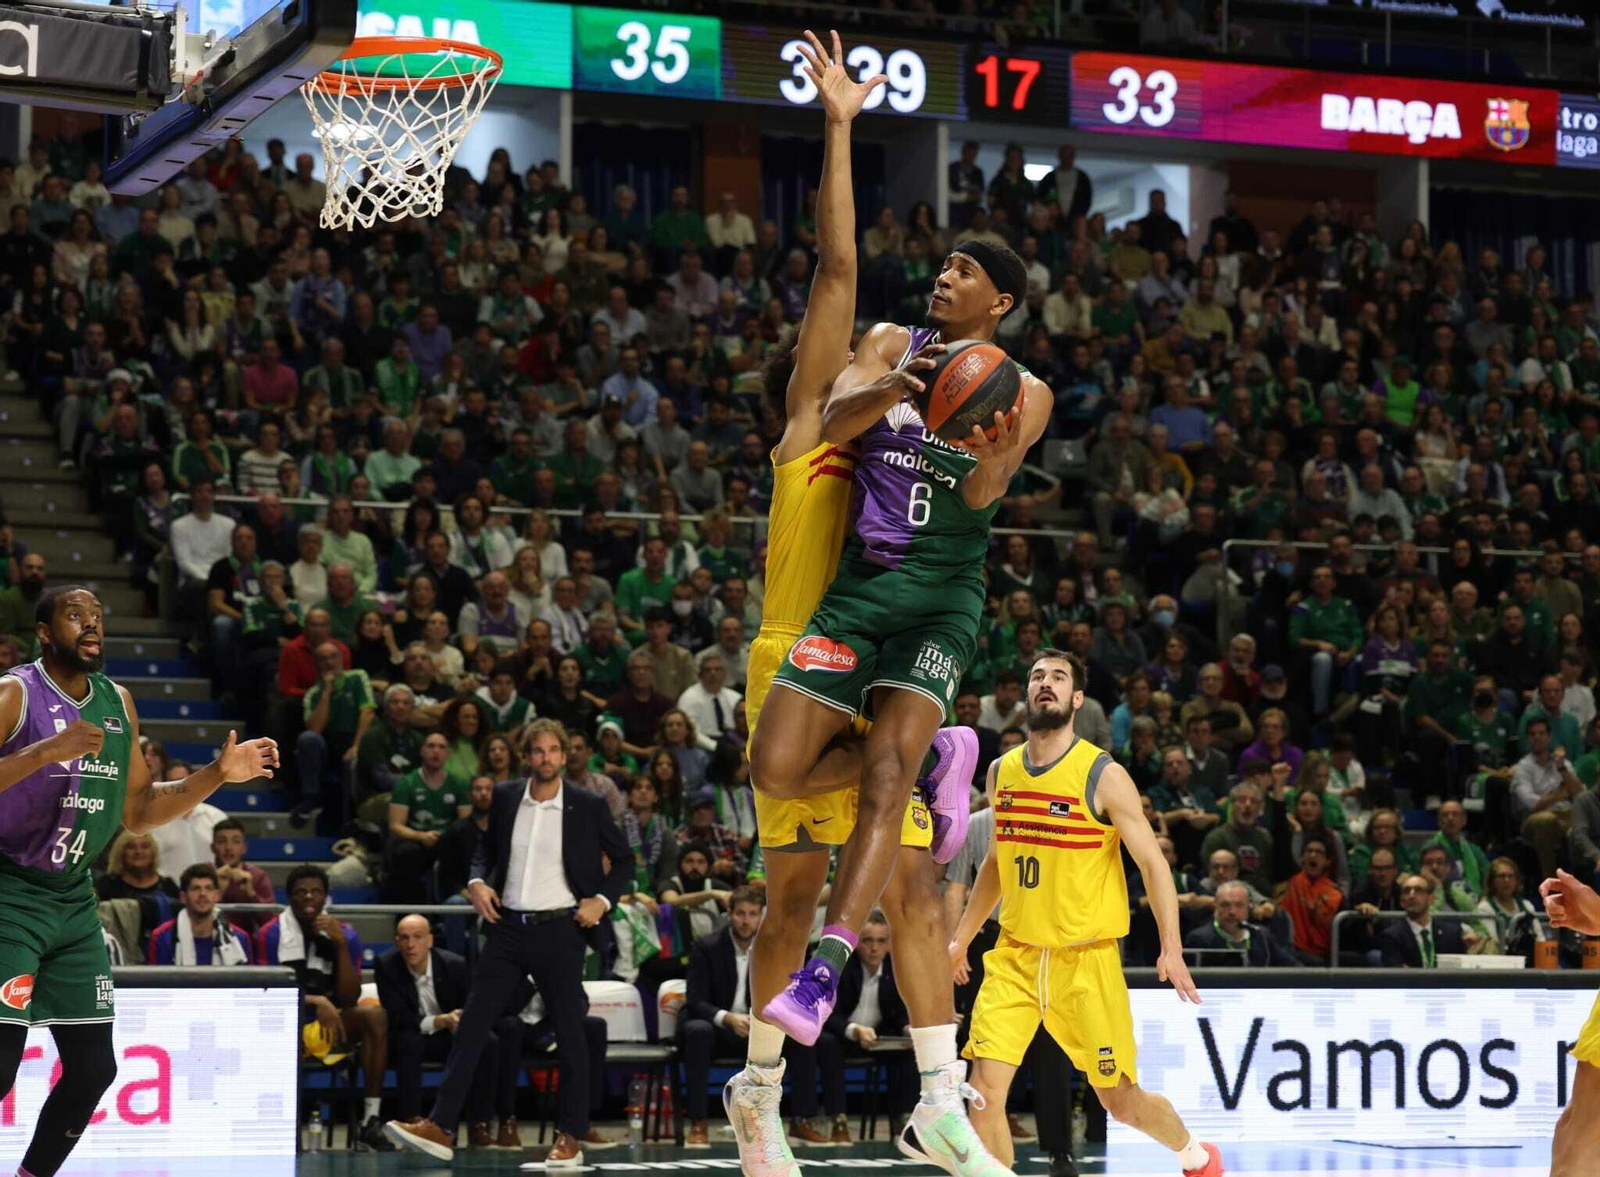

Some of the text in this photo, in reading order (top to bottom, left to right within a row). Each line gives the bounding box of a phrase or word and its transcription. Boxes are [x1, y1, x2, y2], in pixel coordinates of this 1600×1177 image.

[610, 20, 691, 84] 35
[779, 39, 927, 113] 339
[975, 55, 1042, 111] 17
[1103, 66, 1179, 127] 33
[1320, 93, 1462, 144] BARÇA
[907, 482, 933, 526] 6
[78, 759, 119, 777] Unicaja
[51, 826, 88, 865] 34
[1014, 855, 1040, 889] 10
[1197, 1016, 1519, 1111] Vamos
